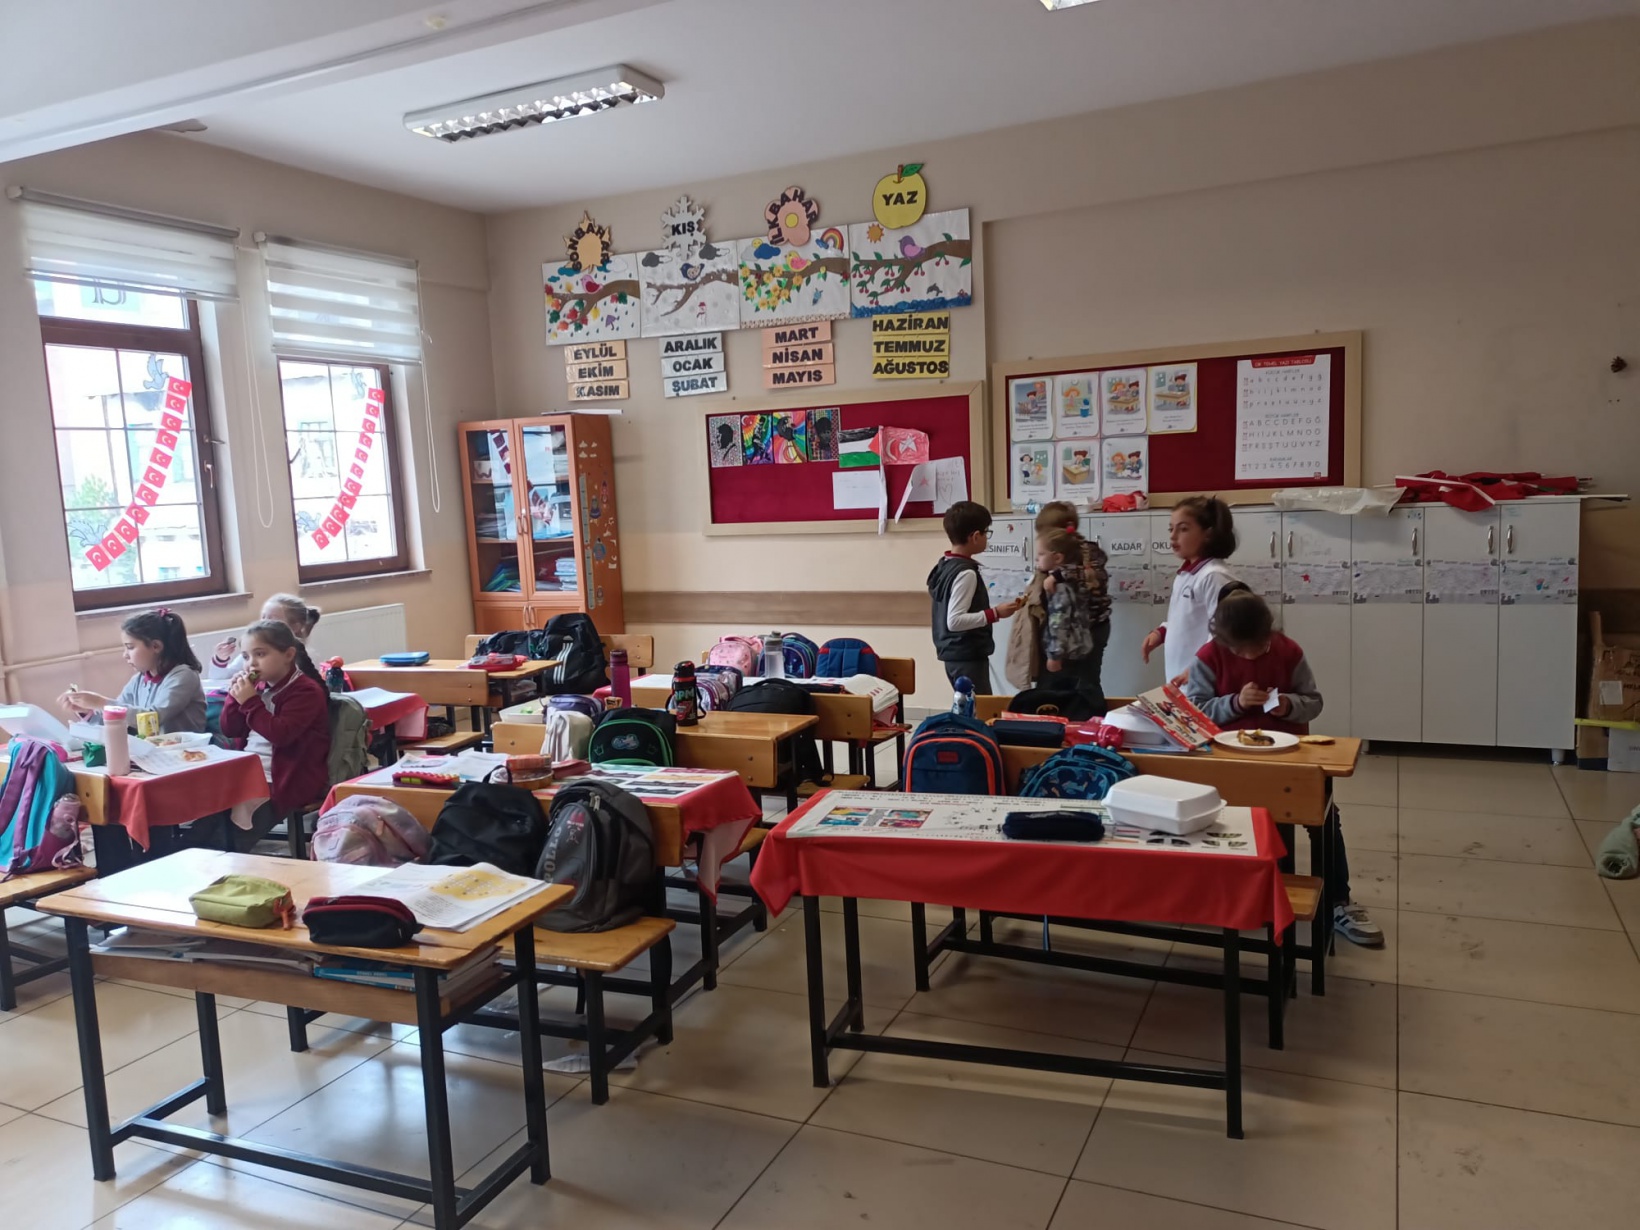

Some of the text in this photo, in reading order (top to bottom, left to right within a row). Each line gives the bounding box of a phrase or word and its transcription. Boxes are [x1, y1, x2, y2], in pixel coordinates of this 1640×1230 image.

[882, 190, 919, 206] YAZ
[767, 188, 818, 245] İLKBAHAR
[671, 221, 696, 236] KIŞ
[568, 222, 610, 272] SONBAHAR
[872, 314, 949, 332] HAZİRAN
[775, 327, 819, 344] MART
[574, 343, 617, 360] EYLÜL
[664, 337, 718, 353] ARALIK
[873, 340, 946, 354] TEMMUZ
[772, 348, 823, 364] NİSAN
[578, 363, 614, 379] EKİM
[672, 358, 713, 373] OCAK
[872, 359, 949, 375] AĞUSTOS
[772, 369, 823, 385] MAYIS
[576, 385, 620, 398] KASIM
[672, 376, 718, 397] ŞUBAT
[1111, 542, 1142, 551] KADAR
[1152, 541, 1172, 550] OKU
[544, 826, 562, 884] POLLO
